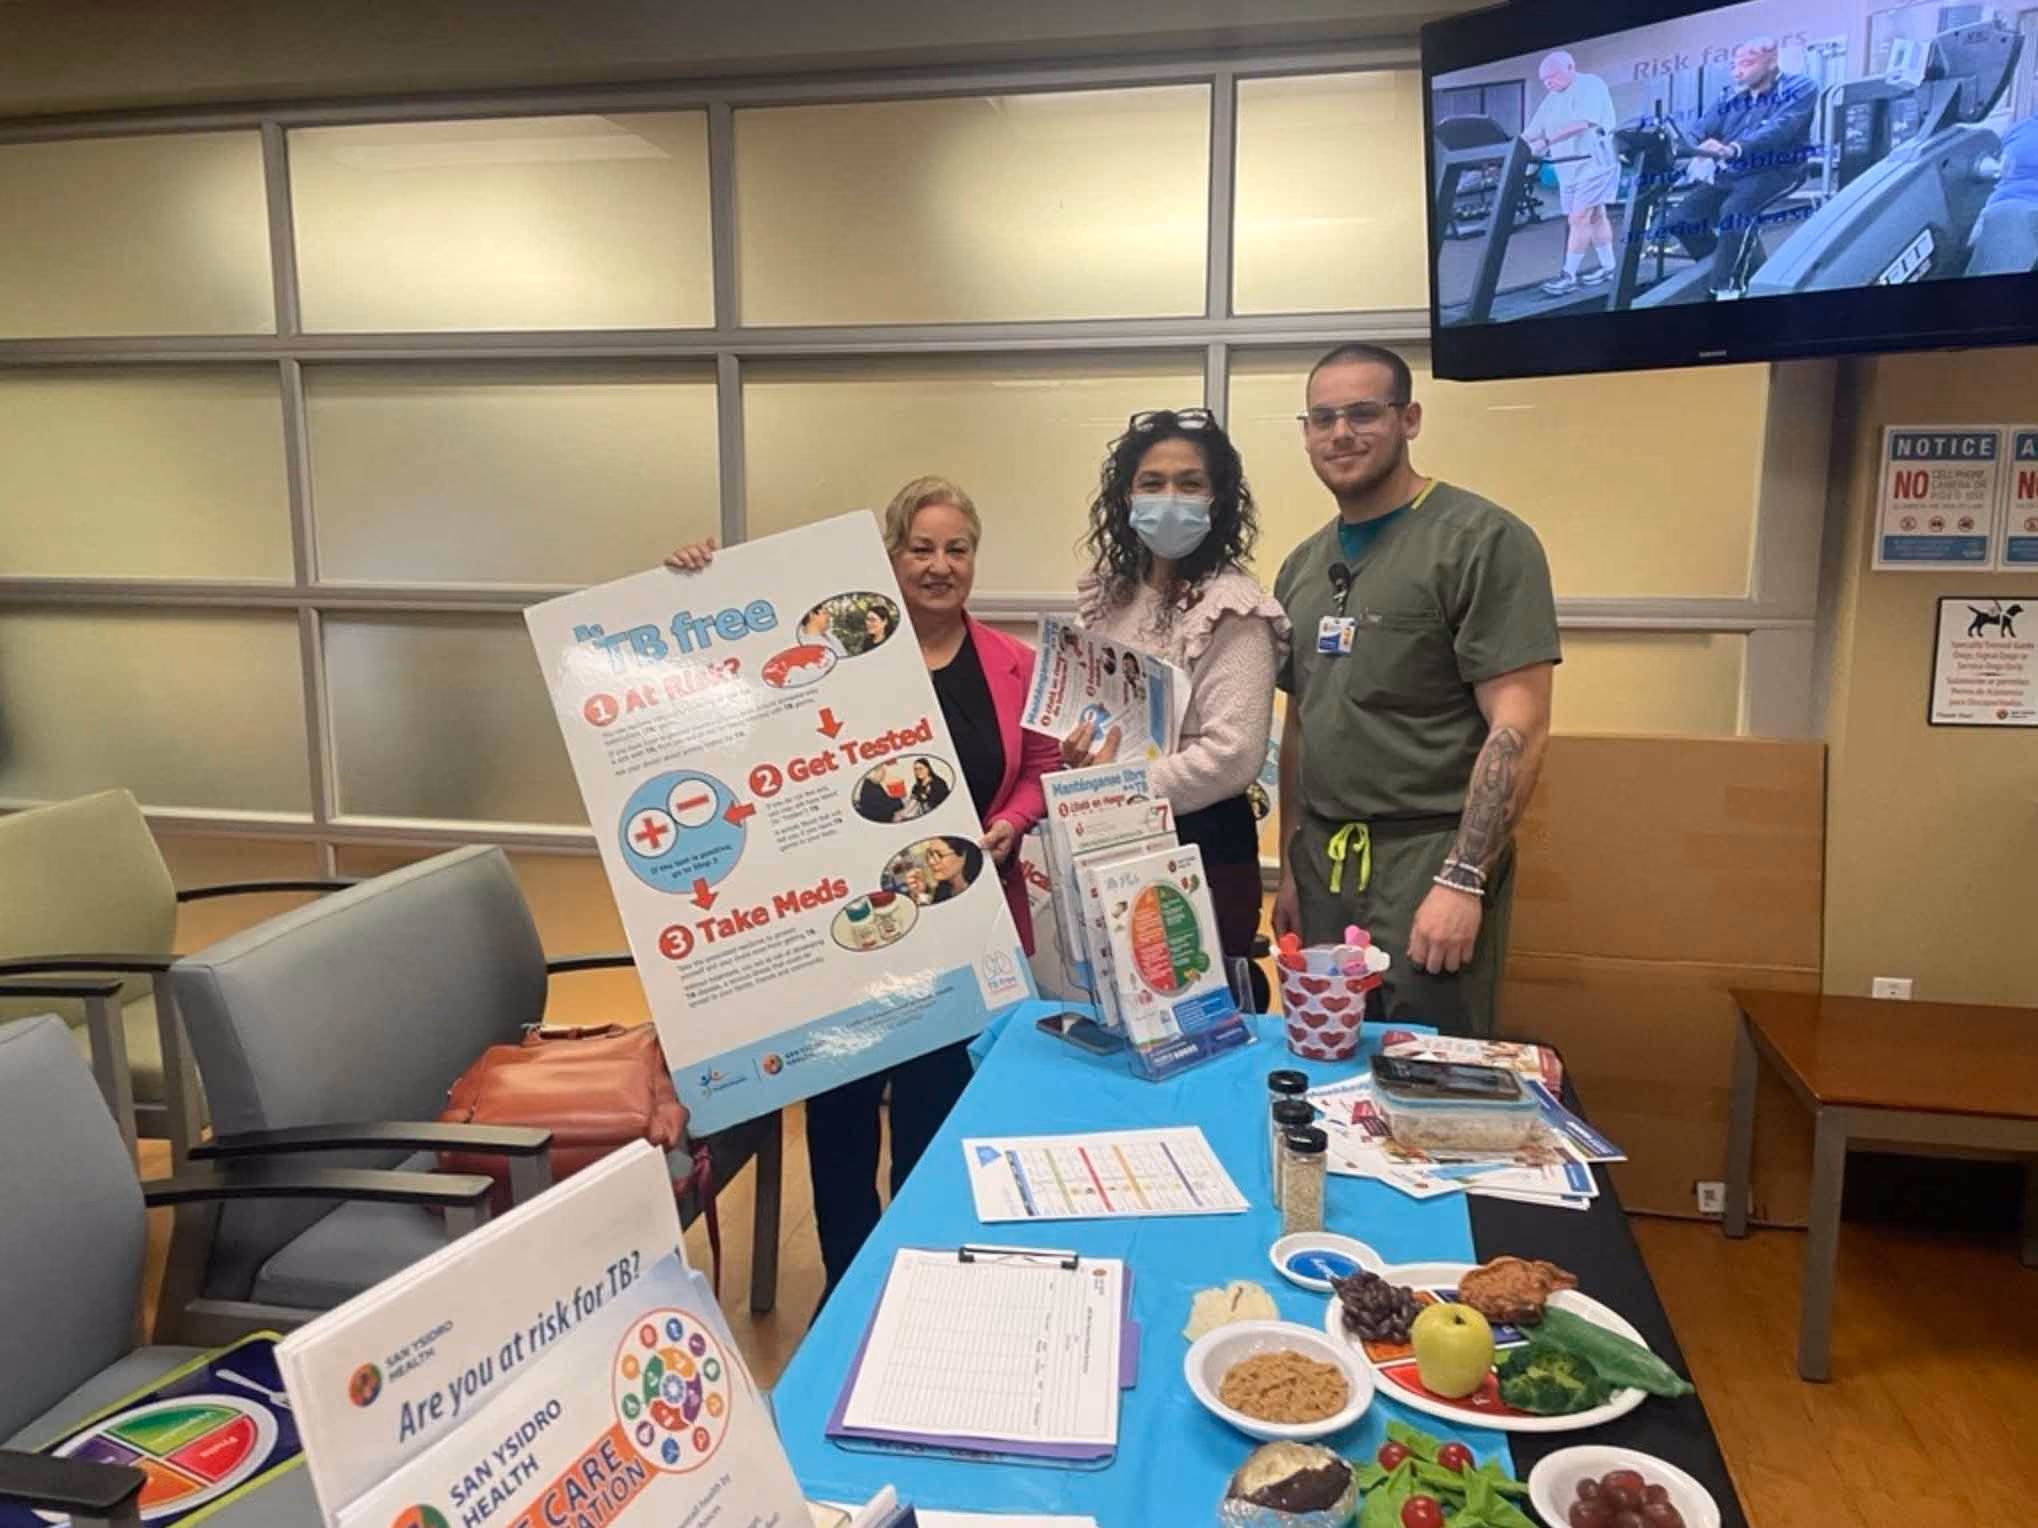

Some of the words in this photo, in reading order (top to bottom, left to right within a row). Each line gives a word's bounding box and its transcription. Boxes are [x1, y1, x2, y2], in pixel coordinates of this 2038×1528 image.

[1634, 54, 1690, 81] Risk
[1702, 31, 1809, 67] facrs
[1897, 437, 1992, 457] NOTICE
[1894, 470, 1930, 499] NO
[2018, 471, 2038, 500] N
[670, 599, 779, 655] free
[625, 684, 661, 714] At
[787, 750, 840, 783] Get
[839, 716, 934, 766] Tested
[696, 904, 771, 944] Take
[772, 877, 850, 919] Meds
[386, 1346, 411, 1367] SAN
[412, 1320, 454, 1350] YSIDRO
[388, 1346, 436, 1382] HEALTH
[399, 1391, 444, 1443] Are
[448, 1354, 493, 1417] you
[500, 1332, 524, 1373] at
[528, 1300, 571, 1352] risk
[572, 1282, 604, 1321] for
[606, 1250, 641, 1298] TB?
[450, 1459, 493, 1507] SAN
[492, 1399, 562, 1467] YSIDRO
[462, 1453, 540, 1528] HEALTH
[543, 1440, 623, 1527] CARE
